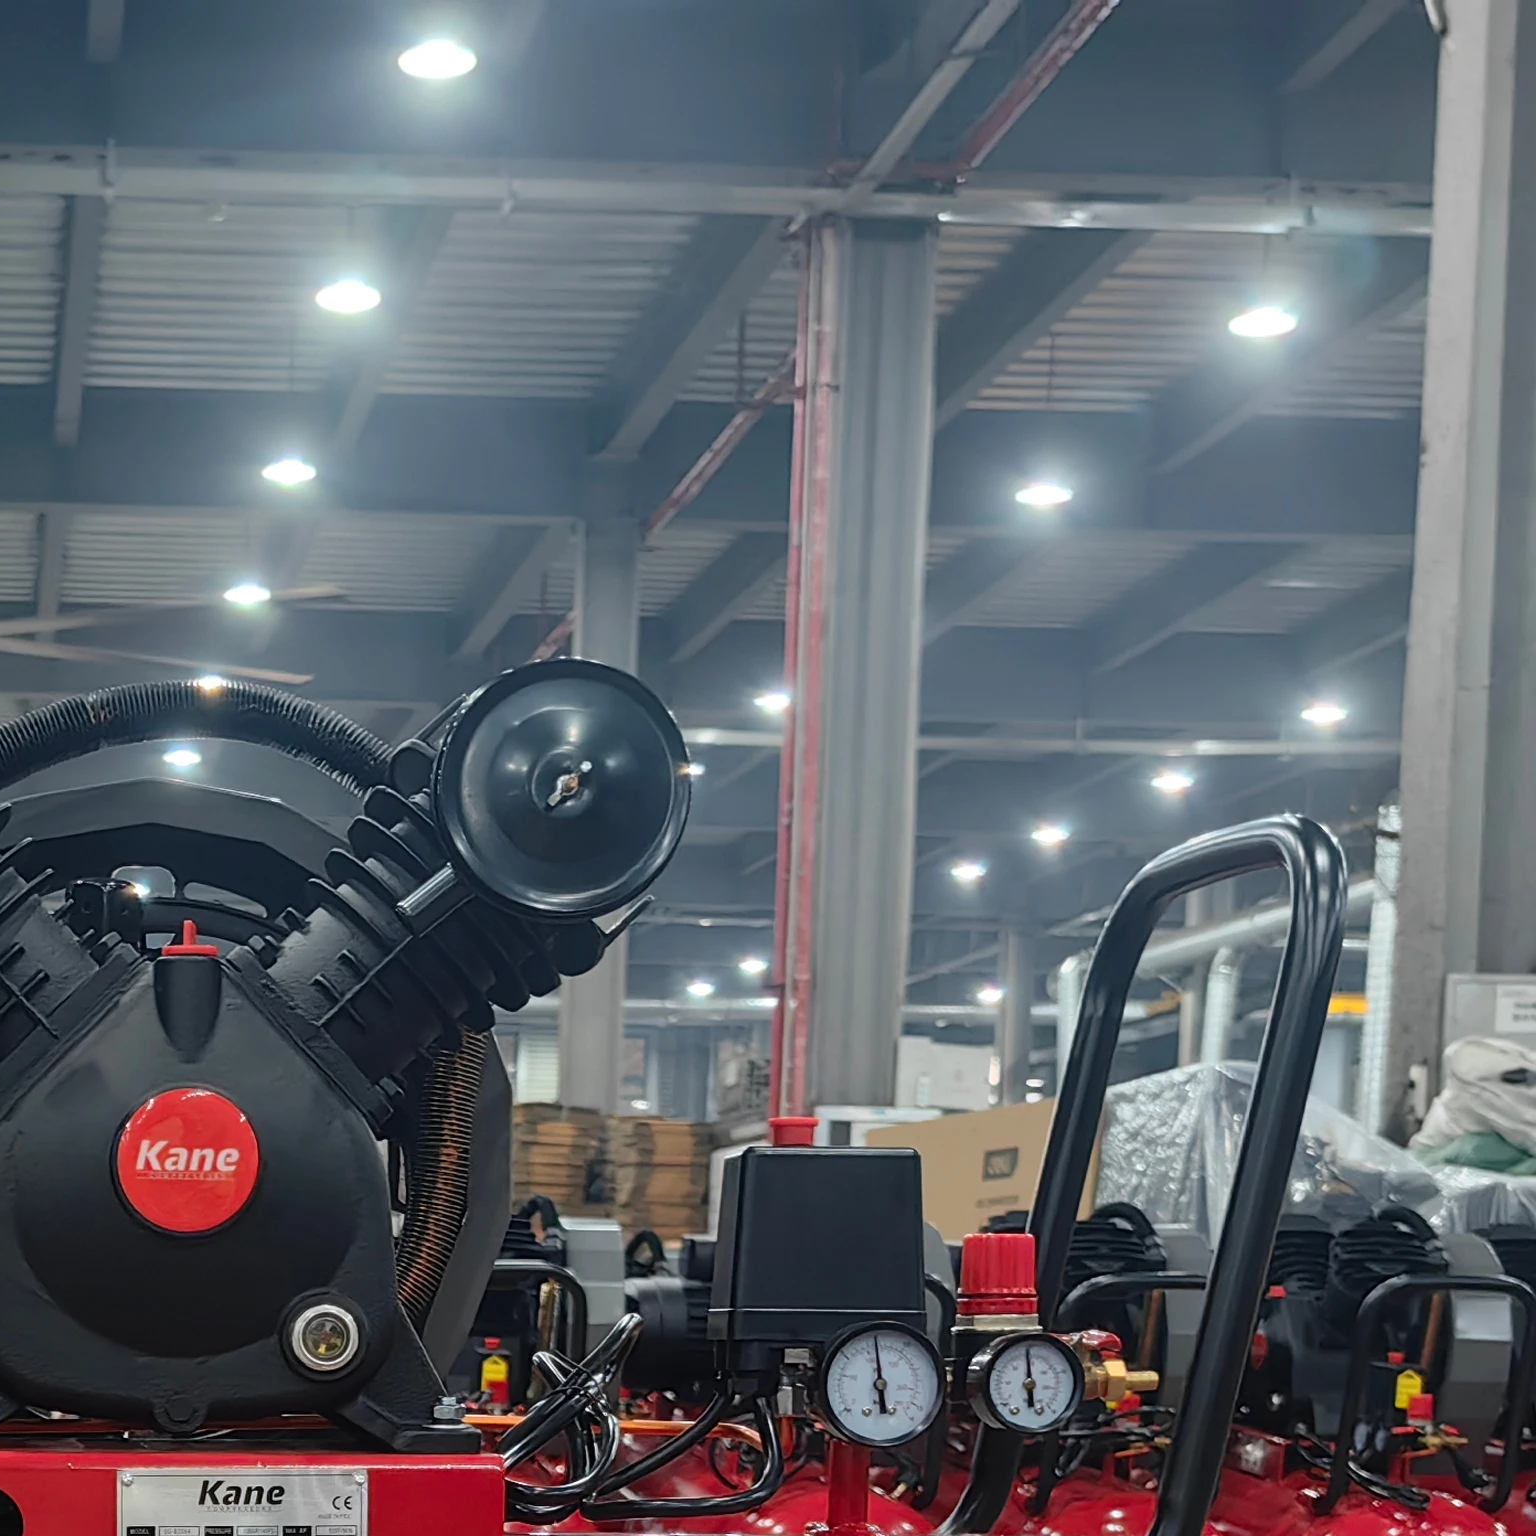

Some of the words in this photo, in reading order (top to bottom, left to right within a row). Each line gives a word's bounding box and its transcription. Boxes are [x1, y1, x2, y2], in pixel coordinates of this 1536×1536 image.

[136, 1140, 240, 1171] Kane
[198, 1480, 285, 1505] Kane
[332, 1496, 352, 1510] CE
